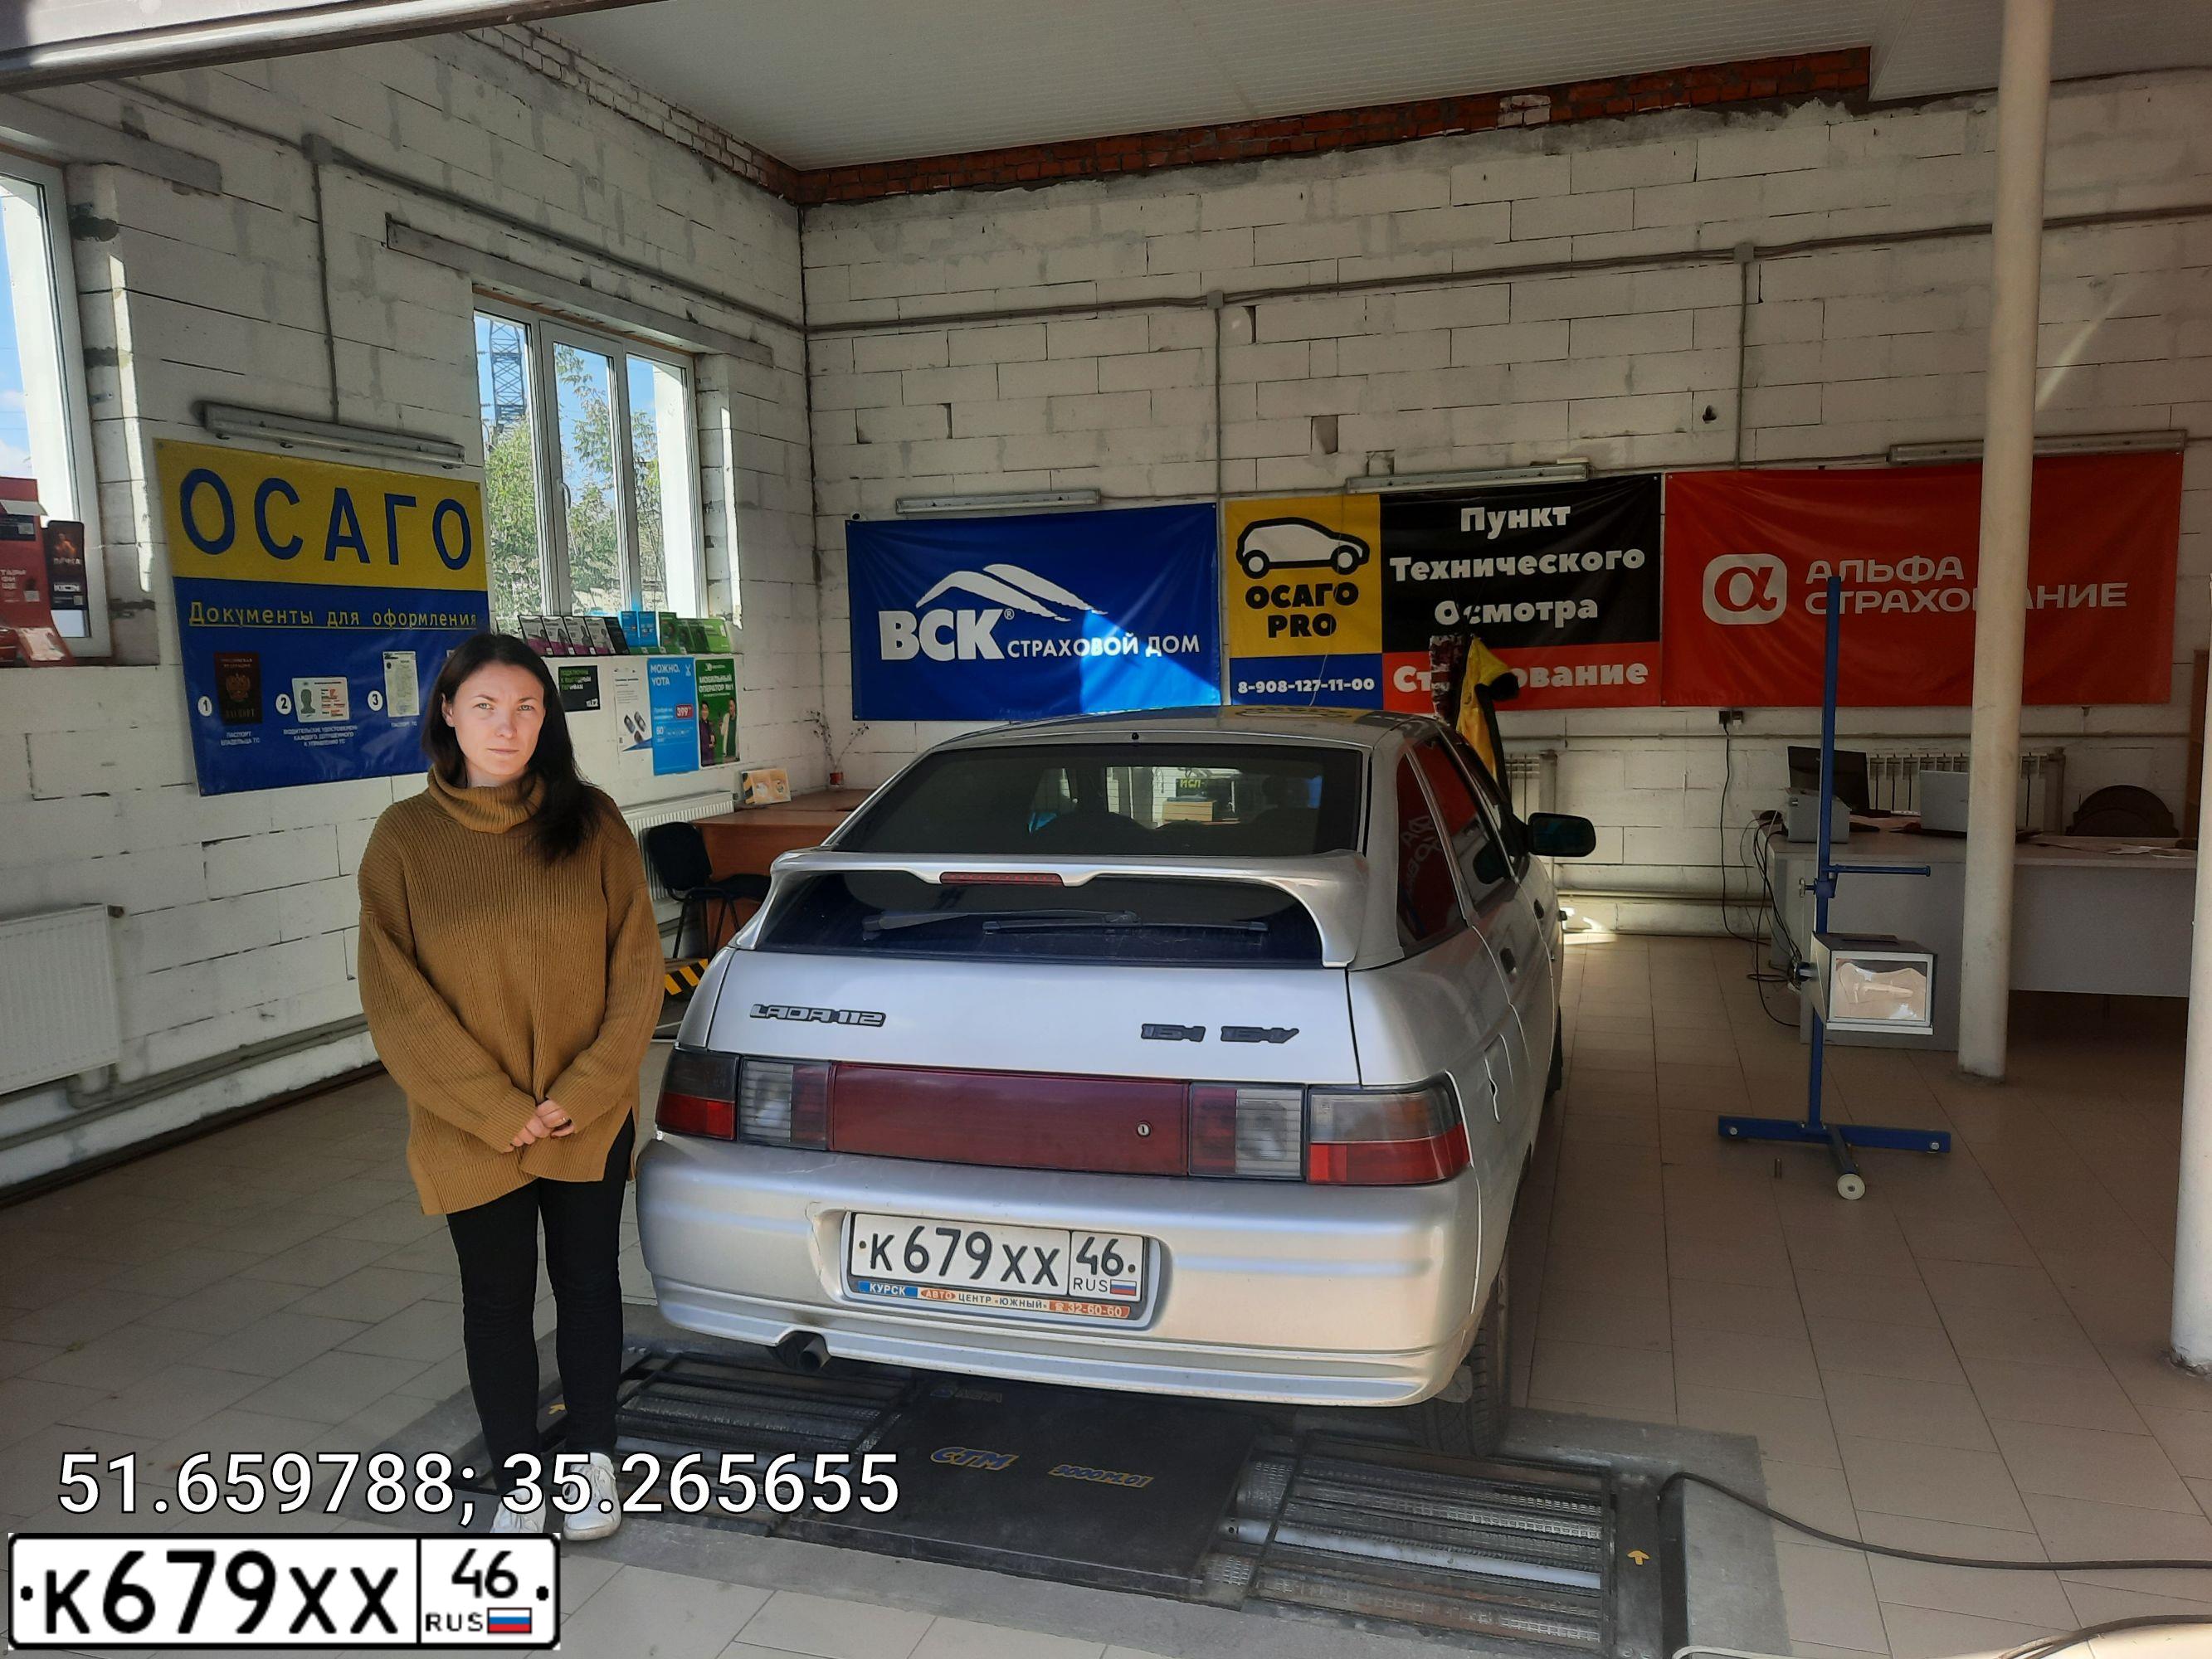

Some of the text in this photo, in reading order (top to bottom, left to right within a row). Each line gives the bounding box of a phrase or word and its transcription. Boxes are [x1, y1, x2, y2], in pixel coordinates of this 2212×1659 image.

[179, 468, 472, 570] ОСАГО
[1460, 506, 1571, 539] Пункт
[1390, 548, 1645, 581] Технического
[1805, 556, 1965, 585] АЛЬФА
[1245, 581, 1359, 611] ОСАГО
[1805, 582, 2129, 615] СТРАХОНИЕ
[188, 601, 477, 628] Документы для оформления
[1267, 613, 1337, 638] PRO
[879, 609, 1005, 660] ВСК
[1007, 632, 1200, 659] СТРАХОВОЙ ДОМ
[651, 677, 670, 687] YOTA
[1237, 678, 1375, 693] 8-908-127-11-00
[1393, 660, 1649, 693] Стование
[203, 700, 208, 711] 1
[280, 698, 288, 709] 2
[372, 694, 378, 705] 3
[750, 1005, 884, 1026] LADA 112
[1076, 1237, 1124, 1277] 46
[870, 1283, 906, 1297] КУРСК
[1073, 1277, 1108, 1293] RUS
[925, 1290, 953, 1301] АВТО
[957, 1294, 992, 1305] ЦЕНТР
[1067, 1303, 1123, 1317] 32-60-60
